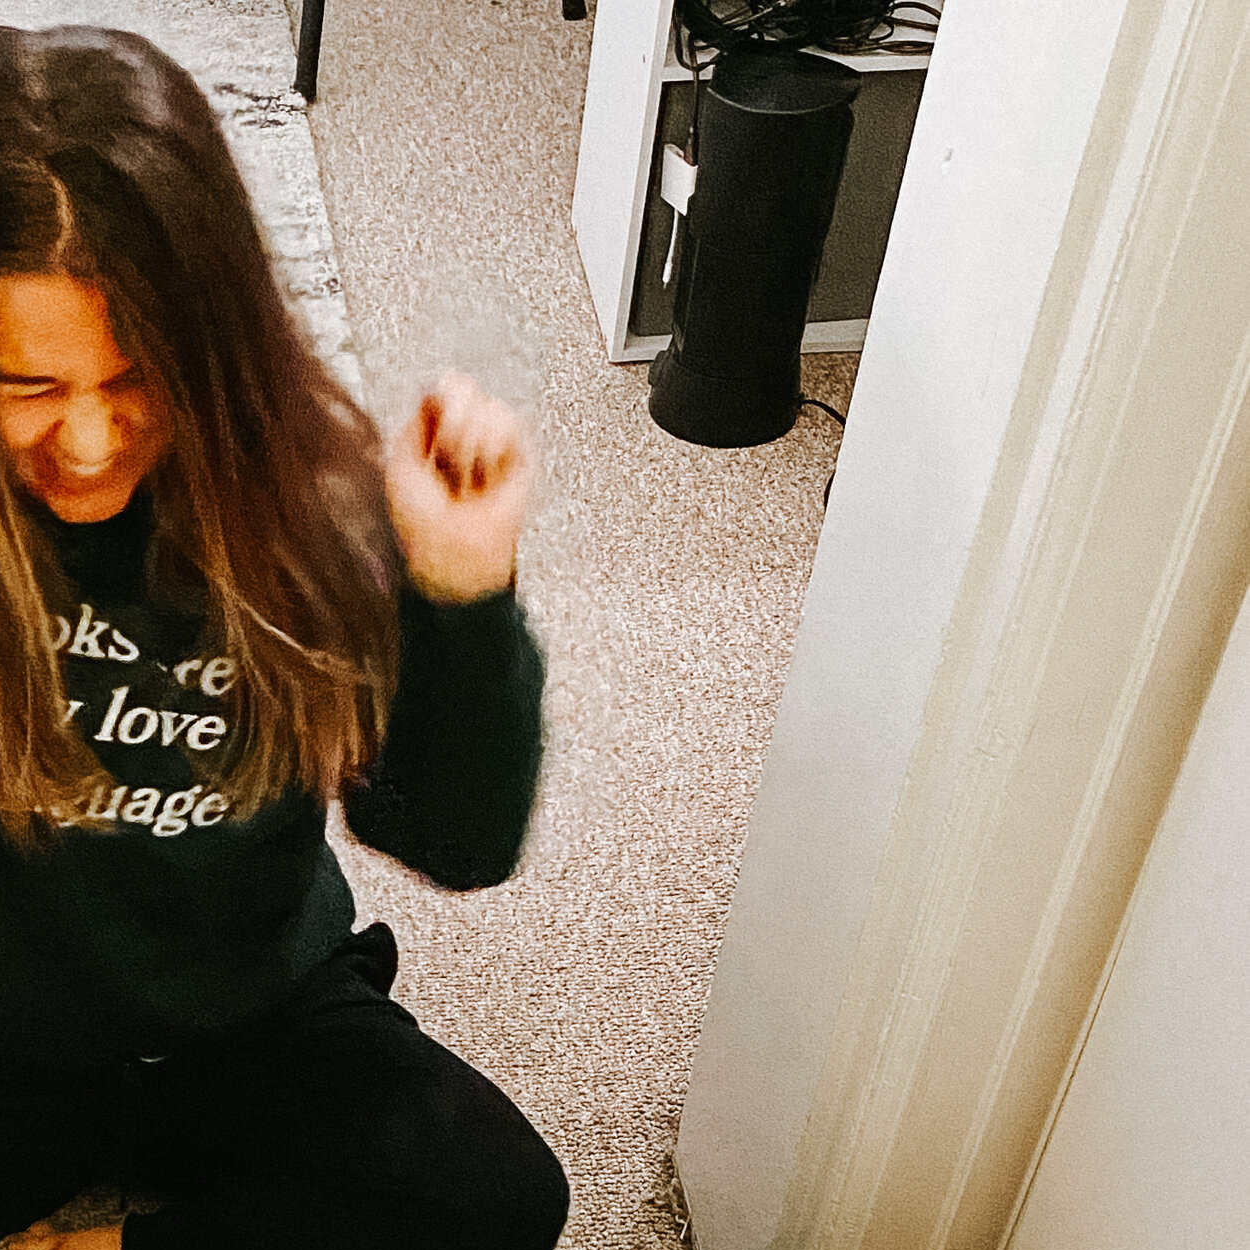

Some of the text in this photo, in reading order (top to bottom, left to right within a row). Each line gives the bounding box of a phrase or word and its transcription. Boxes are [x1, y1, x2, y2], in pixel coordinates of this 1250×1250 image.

[51, 603, 237, 697] oks re
[93, 686, 227, 751] love
[60, 784, 229, 837] uage
